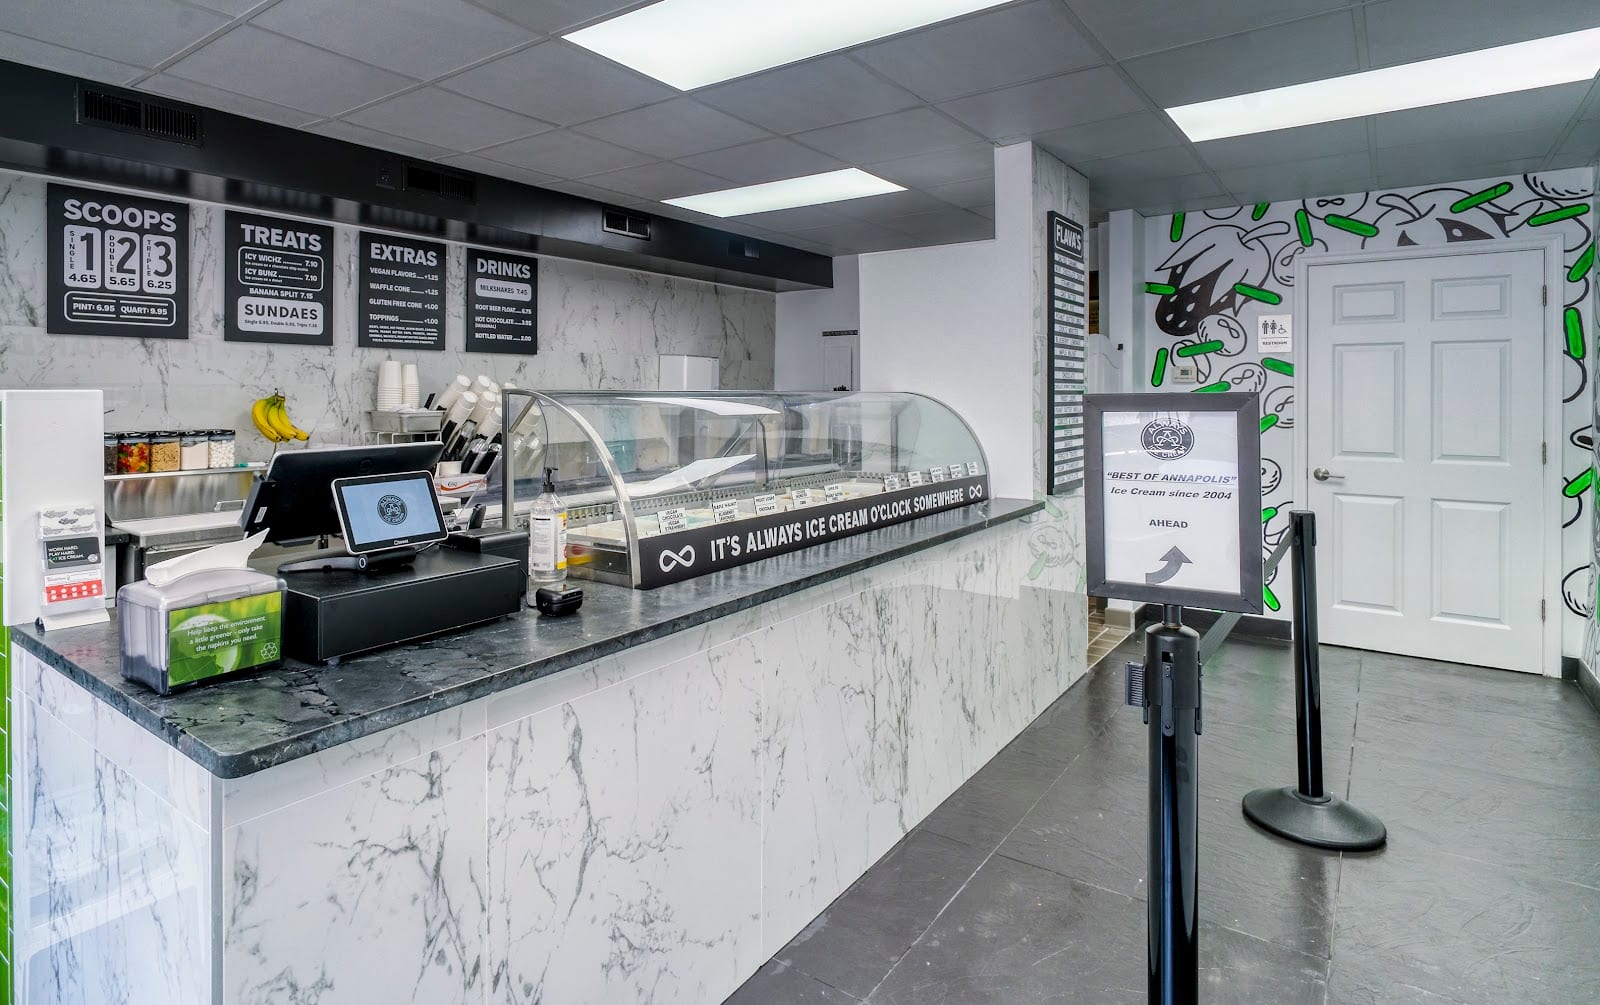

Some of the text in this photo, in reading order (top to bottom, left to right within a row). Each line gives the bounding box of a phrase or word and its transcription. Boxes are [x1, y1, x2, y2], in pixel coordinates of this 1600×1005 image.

[64, 199, 176, 232] SCOOPS
[241, 224, 321, 251] TREATS
[81, 233, 93, 270] 1
[117, 237, 136, 274] 2
[371, 243, 437, 266] EXTRAS
[154, 241, 172, 277] 3
[259, 255, 282, 263] WICHZ
[305, 260, 318, 268] 7.10
[370, 267, 390, 275] VEGAN
[391, 269, 416, 278] FLAVORS
[477, 258, 531, 279] DRINKS
[69, 274, 96, 283] 4.65
[110, 277, 135, 286] 5.65
[148, 280, 171, 289] 6.25
[370, 283, 393, 291] WAFFLE
[480, 284, 514, 294] MILKSHAKES
[250, 288, 279, 296] BANANA
[97, 304, 114, 312] 6.95
[369, 299, 392, 307] GLUTEN
[121, 306, 149, 314] QUART:
[245, 304, 318, 320] SUNDAES
[369, 314, 399, 322] TOPPINGS
[1148, 420, 1187, 434] ALWAYS
[1131, 488, 1165, 496] Cream
[1169, 489, 1199, 498] since
[1203, 491, 1232, 500] 2004
[746, 522, 802, 553] ALWAYS
[806, 517, 826, 539] ICE
[829, 508, 868, 533] CREAM
[914, 488, 964, 512] SOMEWHERE
[1149, 519, 1187, 528] AHEAD
[230, 616, 266, 627] environment
[210, 632, 232, 641] greener
[238, 627, 250, 635] only
[208, 640, 229, 649] napkins
[231, 638, 241, 646] you
